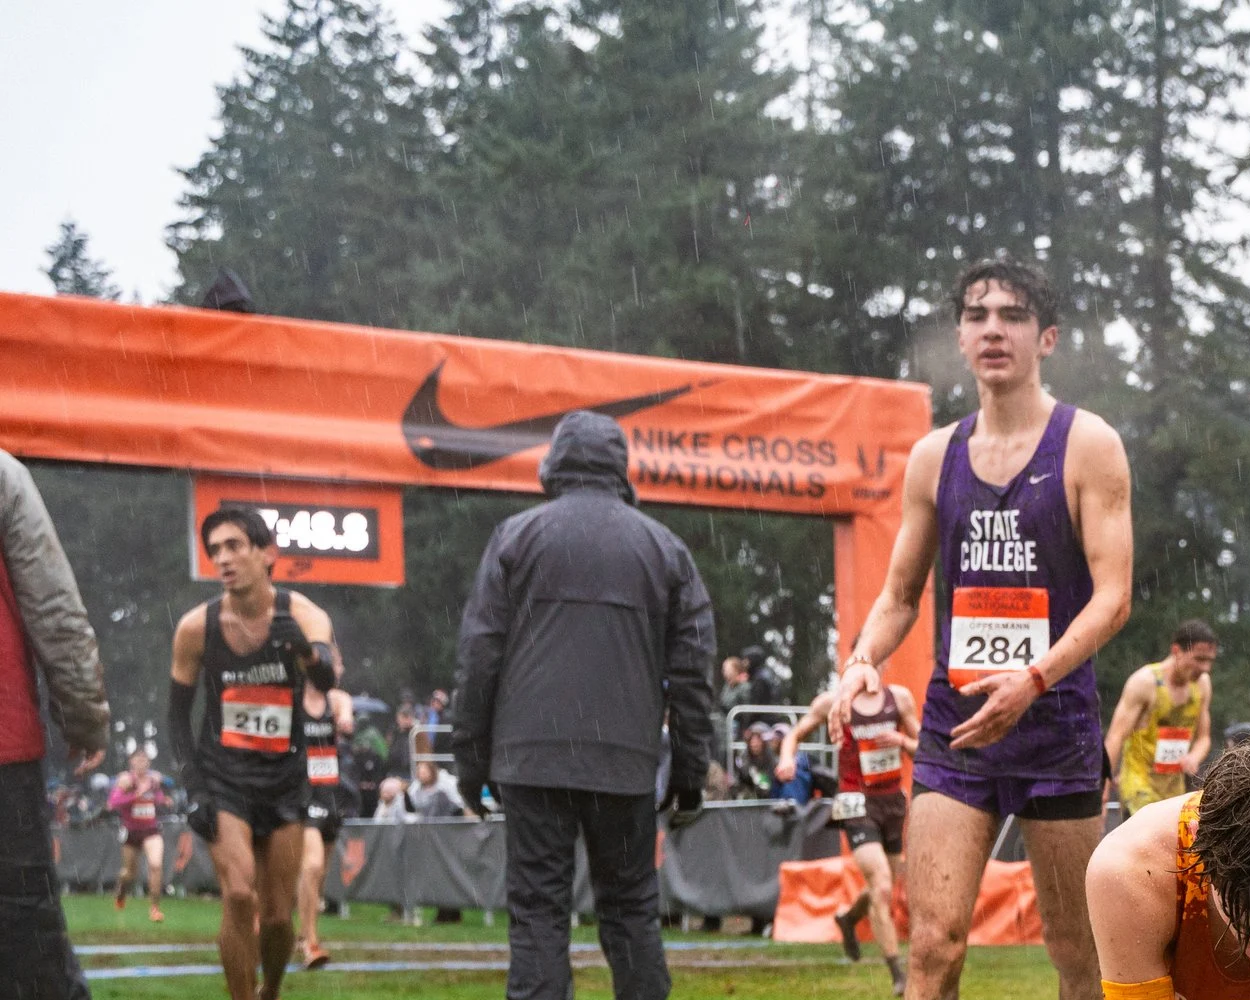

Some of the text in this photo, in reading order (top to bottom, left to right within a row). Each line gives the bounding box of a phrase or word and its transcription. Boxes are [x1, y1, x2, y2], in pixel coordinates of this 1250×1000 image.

[631, 427, 837, 467] NIKE CROSS
[638, 459, 826, 498] NATIONALS
[970, 509, 1021, 541] STATE
[960, 540, 1038, 572] COLLEGE
[968, 601, 1031, 611] NATIONALS
[964, 636, 1034, 666] 284
[235, 712, 280, 734] 216
